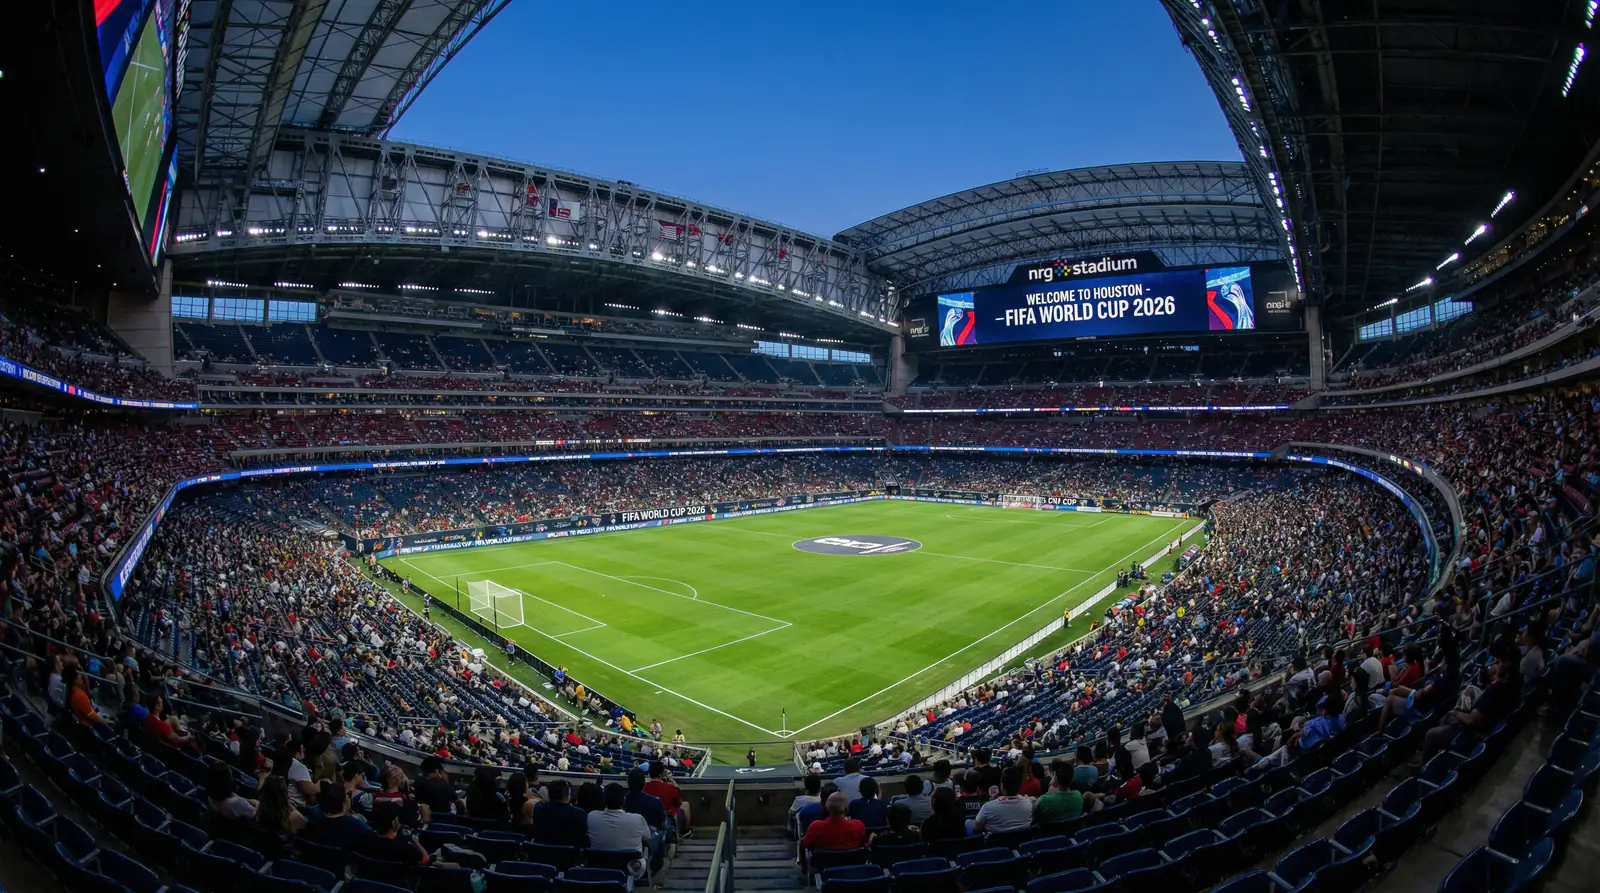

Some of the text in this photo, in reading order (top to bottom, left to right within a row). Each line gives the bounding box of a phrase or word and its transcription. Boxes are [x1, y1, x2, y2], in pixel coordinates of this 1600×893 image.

[1028, 257, 1138, 282] nrg stadium
[1026, 290, 1075, 305] WELCOME
[1077, 288, 1091, 300] TO
[1093, 284, 1143, 299] HOUSTON
[1039, 302, 1094, 324] WORLD
[1097, 299, 1129, 319] CUP
[1133, 296, 1176, 317] 2026
[622, 511, 641, 523] FIFA
[640, 508, 669, 520] WORLD
[670, 507, 686, 517] CUP
[686, 505, 706, 515] 2026
